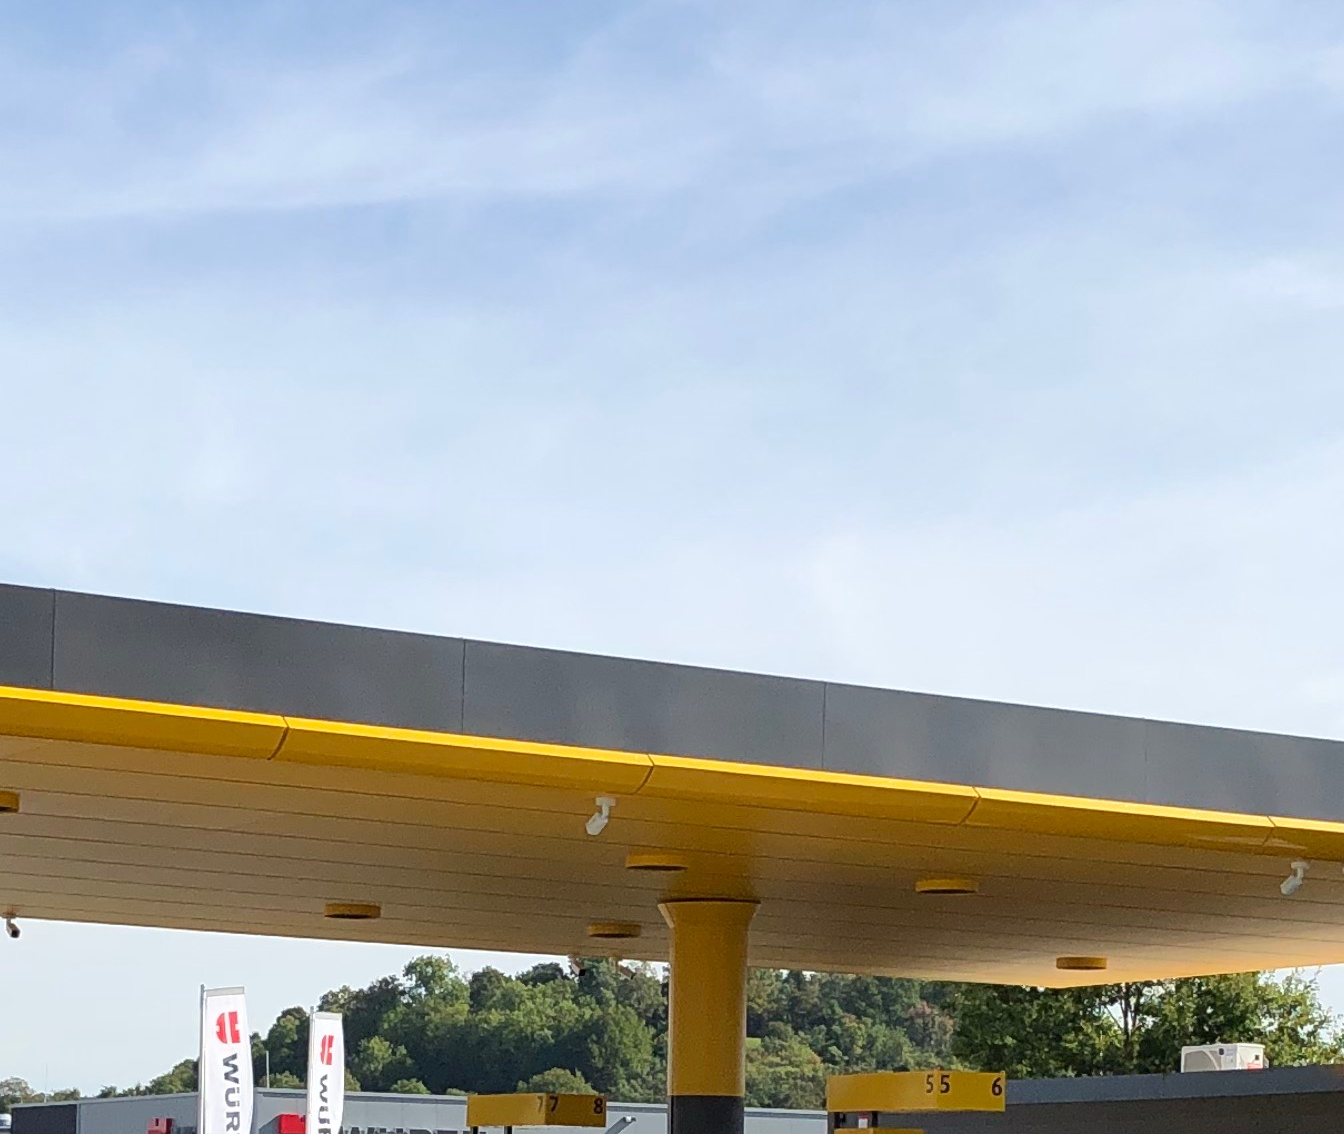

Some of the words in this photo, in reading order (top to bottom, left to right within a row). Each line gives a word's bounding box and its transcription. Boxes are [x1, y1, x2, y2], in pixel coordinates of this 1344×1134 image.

[926, 1074, 934, 1093] 5
[940, 1074, 950, 1093] 5
[992, 1077, 1002, 1096] 6
[549, 1096, 558, 1112] 7
[594, 1098, 603, 1114] 8
